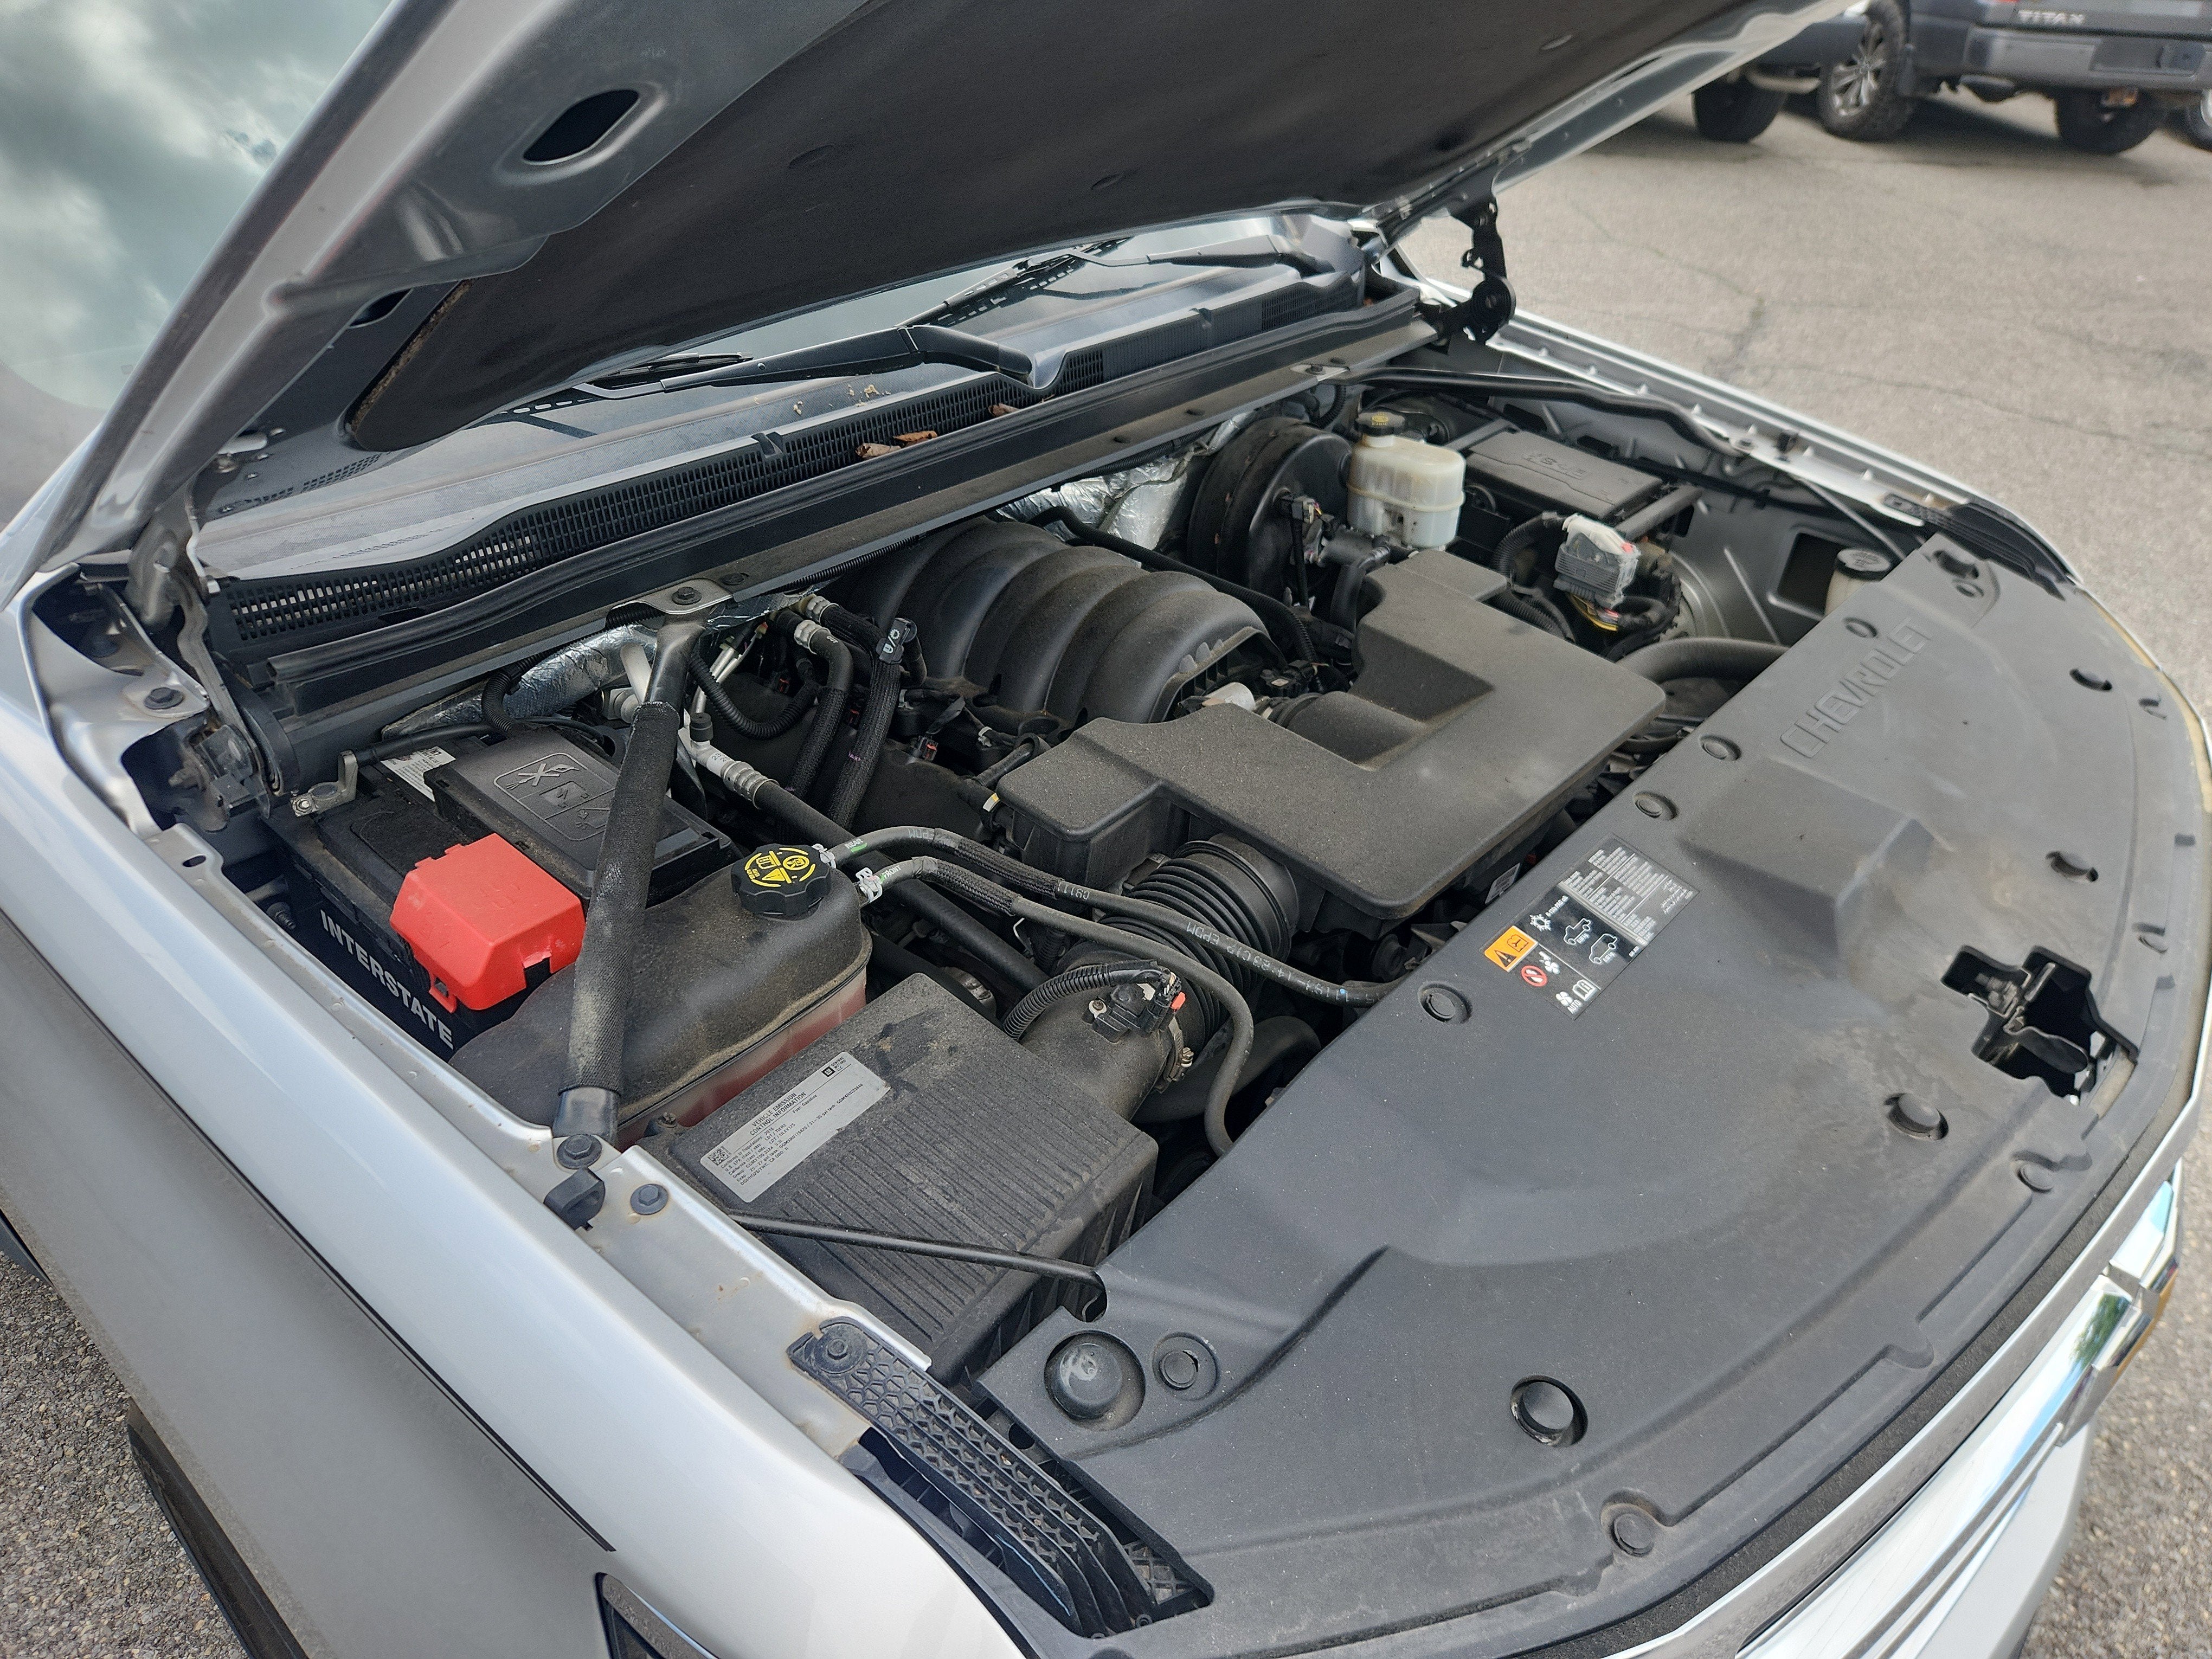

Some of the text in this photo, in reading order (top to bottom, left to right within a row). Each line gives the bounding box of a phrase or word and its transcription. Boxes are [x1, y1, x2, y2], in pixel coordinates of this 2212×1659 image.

[2018, 10, 2085, 25] TITAN
[1779, 617, 1932, 758] CHEVROLET
[845, 838, 864, 849] REAR
[882, 865, 902, 879] FRONT
[1186, 922, 1220, 946] EPDM
[320, 909, 454, 1050] INTERSTATE
[1567, 999, 1582, 1014] AUTO
[749, 1091, 807, 1136] CONTROL INFORMATION
[751, 1092, 797, 1127] VEHICLE EMISSION
